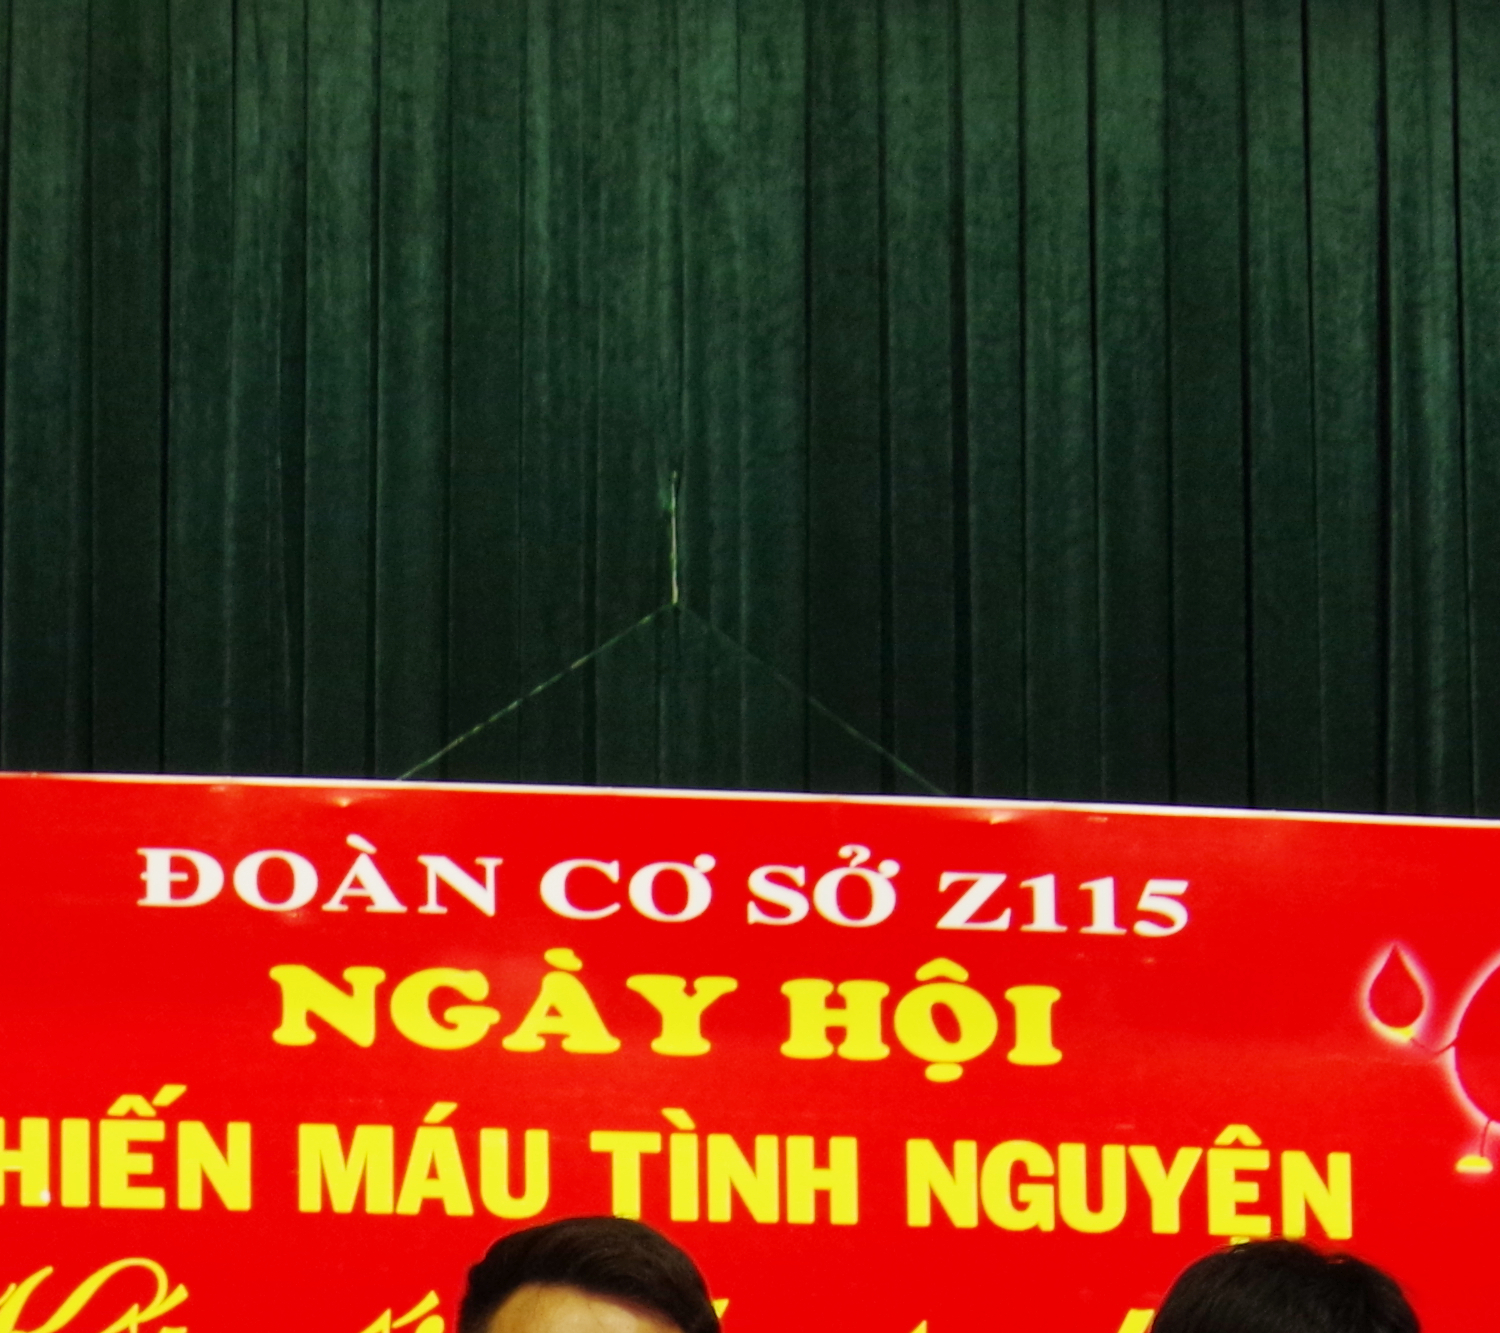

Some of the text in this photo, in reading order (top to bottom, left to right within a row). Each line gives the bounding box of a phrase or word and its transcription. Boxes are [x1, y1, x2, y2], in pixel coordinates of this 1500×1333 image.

[138, 834, 1189, 937] ĐOÀN CƠ SỞ Z115
[269, 948, 1063, 1082] NGÀY HỘI
[297, 1102, 550, 1220] MÁU
[589, 1108, 859, 1222] TÌNH
[905, 1124, 1353, 1244] NGUYỆN
